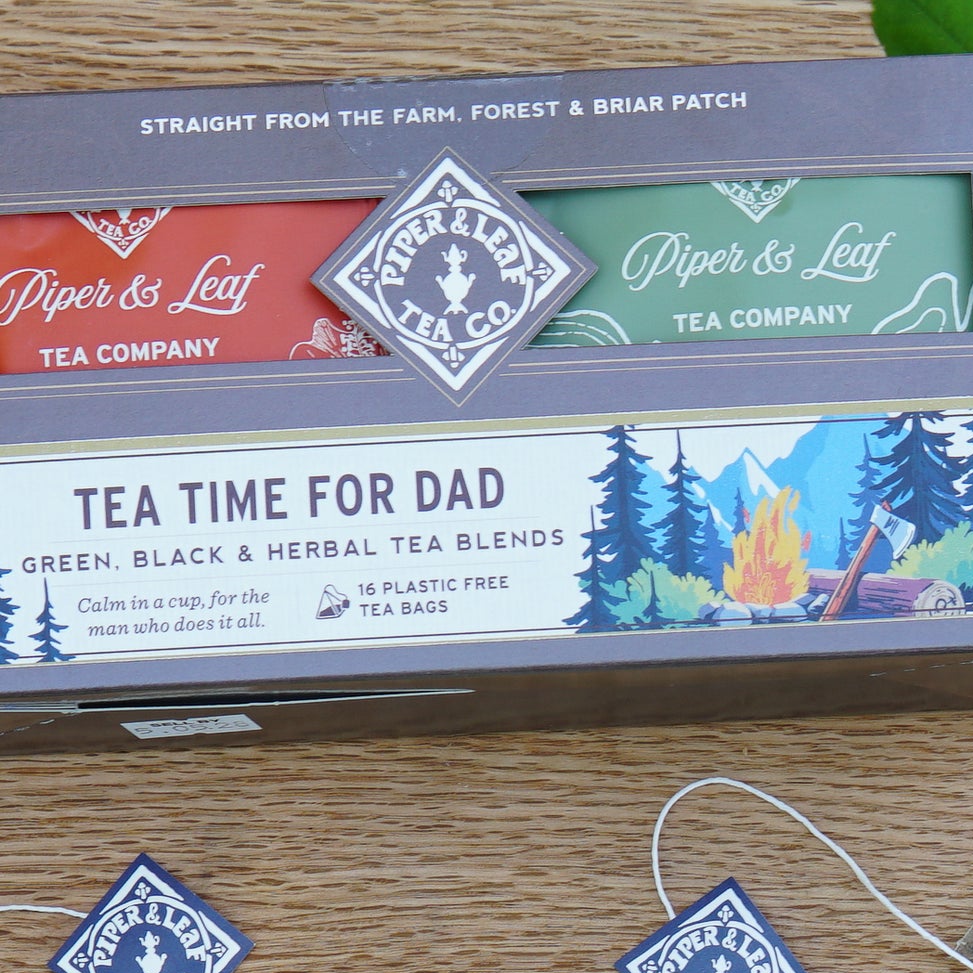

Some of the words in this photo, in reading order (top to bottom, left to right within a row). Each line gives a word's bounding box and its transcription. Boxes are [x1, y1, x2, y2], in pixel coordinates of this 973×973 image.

[140, 113, 258, 135] STRAIGHT
[265, 109, 330, 130] FROM
[338, 107, 385, 127] THE
[471, 101, 560, 121] FOREST
[568, 99, 585, 116] &
[593, 95, 665, 115] BRIAR
[672, 91, 748, 112] PATCH
[730, 182, 757, 202] TEA
[98, 218, 124, 237] TEA
[380, 209, 448, 287] PIPER
[450, 207, 471, 237] &
[621, 231, 749, 291] Piper
[752, 239, 795, 276] &
[801, 222, 896, 283] Leaf
[0, 265, 113, 326] Piper
[119, 274, 162, 309] &
[168, 254, 266, 315] Leaf
[398, 299, 454, 342] TEA
[465, 300, 517, 339] CO.
[673, 313, 723, 333] TEA
[729, 303, 852, 330] COMPANY
[40, 345, 89, 367] TEA
[96, 337, 220, 364] COMPANY
[74, 484, 161, 531] TEA
[179, 477, 288, 524] TIME
[308, 472, 406, 518] FOR
[415, 466, 506, 513] DAD
[21, 552, 120, 575] GREEN,
[133, 544, 224, 569] BLACK
[238, 543, 254, 563] &
[267, 538, 378, 562] HERBAL
[391, 535, 443, 556] TEA
[457, 528, 565, 551] BLENDS
[358, 581, 377, 596] 16
[383, 579, 458, 595] PLASTIC
[464, 575, 510, 591] FREE
[77, 594, 127, 614] Calm
[132, 594, 150, 611] in
[153, 598, 164, 610] a
[167, 594, 206, 614] cup,
[208, 589, 242, 611] for
[246, 588, 270, 605] the
[360, 602, 395, 617] TEA
[401, 599, 449, 615] BAGS
[88, 621, 130, 638] man
[134, 617, 169, 636] who
[173, 614, 217, 634] does
[220, 613, 232, 631] it
[234, 611, 266, 630] all.
[150, 719, 188, 728] SELL
[92, 905, 144, 967] PIPER
[145, 902, 162, 925] &
[720, 928, 737, 951] &
